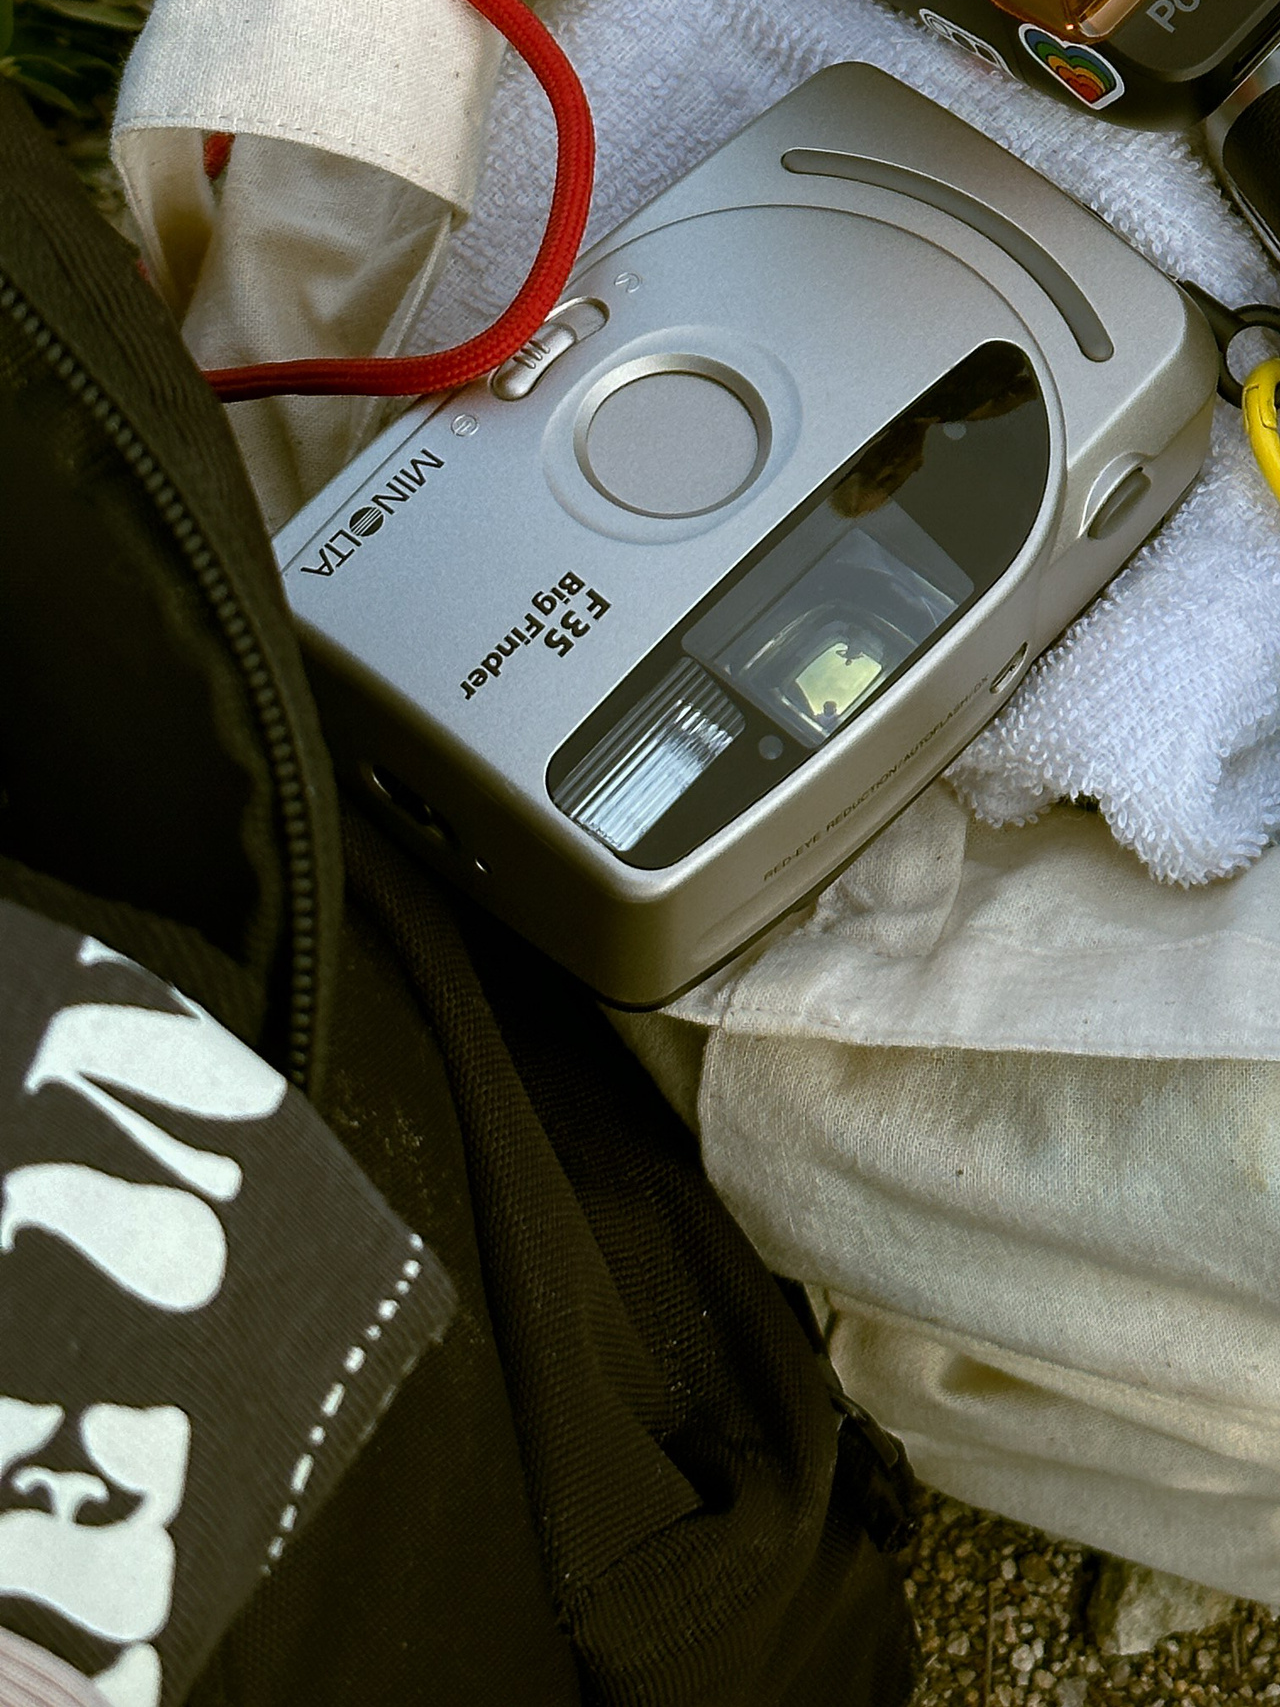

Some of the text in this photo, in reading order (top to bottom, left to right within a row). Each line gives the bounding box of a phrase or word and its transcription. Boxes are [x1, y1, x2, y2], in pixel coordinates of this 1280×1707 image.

[300, 448, 445, 577] MINOLTA
[460, 570, 586, 701] Big Finder
